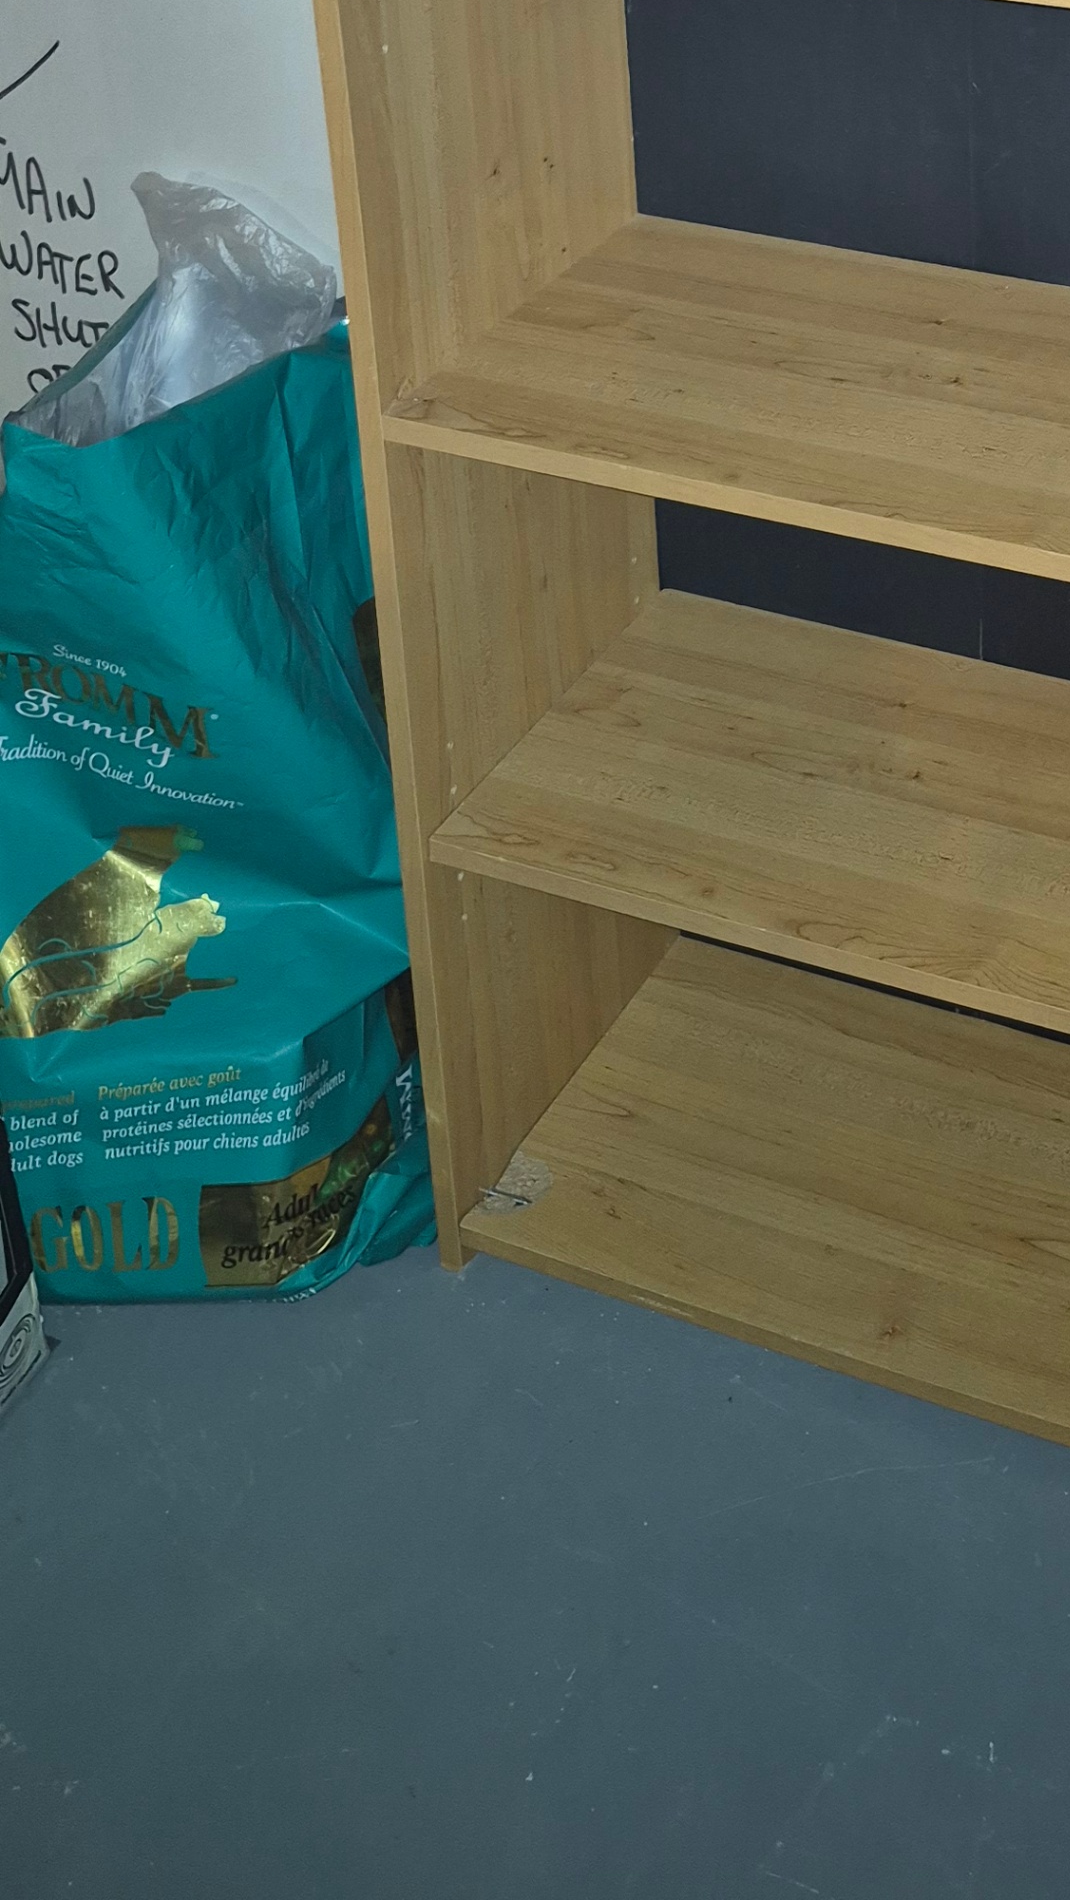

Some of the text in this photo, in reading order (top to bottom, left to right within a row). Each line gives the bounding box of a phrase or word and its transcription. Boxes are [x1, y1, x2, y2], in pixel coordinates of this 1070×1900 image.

[0, 229, 125, 299] WATER
[12, 298, 110, 349] SHUT
[53, 644, 127, 678] Since 1904
[0, 651, 219, 760] ROMM
[15, 688, 175, 768] Family
[70, 747, 91, 771] of
[88, 752, 135, 786] Quiet
[135, 771, 236, 809] Innovation
[98, 1065, 242, 1101] Préparée avec goût
[10, 1108, 79, 1131] blend of
[99, 1106, 109, 1120] à
[114, 1100, 162, 1122] partir
[165, 1096, 201, 1113] d'un
[205, 1088, 269, 1106] mélange
[102, 1121, 173, 1141] protéines
[176, 1106, 273, 1129] sélectionnées
[277, 1106, 293, 1122] et
[47, 1150, 84, 1168] dogs
[105, 1138, 171, 1160] nutritifs
[174, 1137, 211, 1155] pour
[213, 1132, 260, 1149] chiens
[30, 1195, 181, 1274] GOLD
